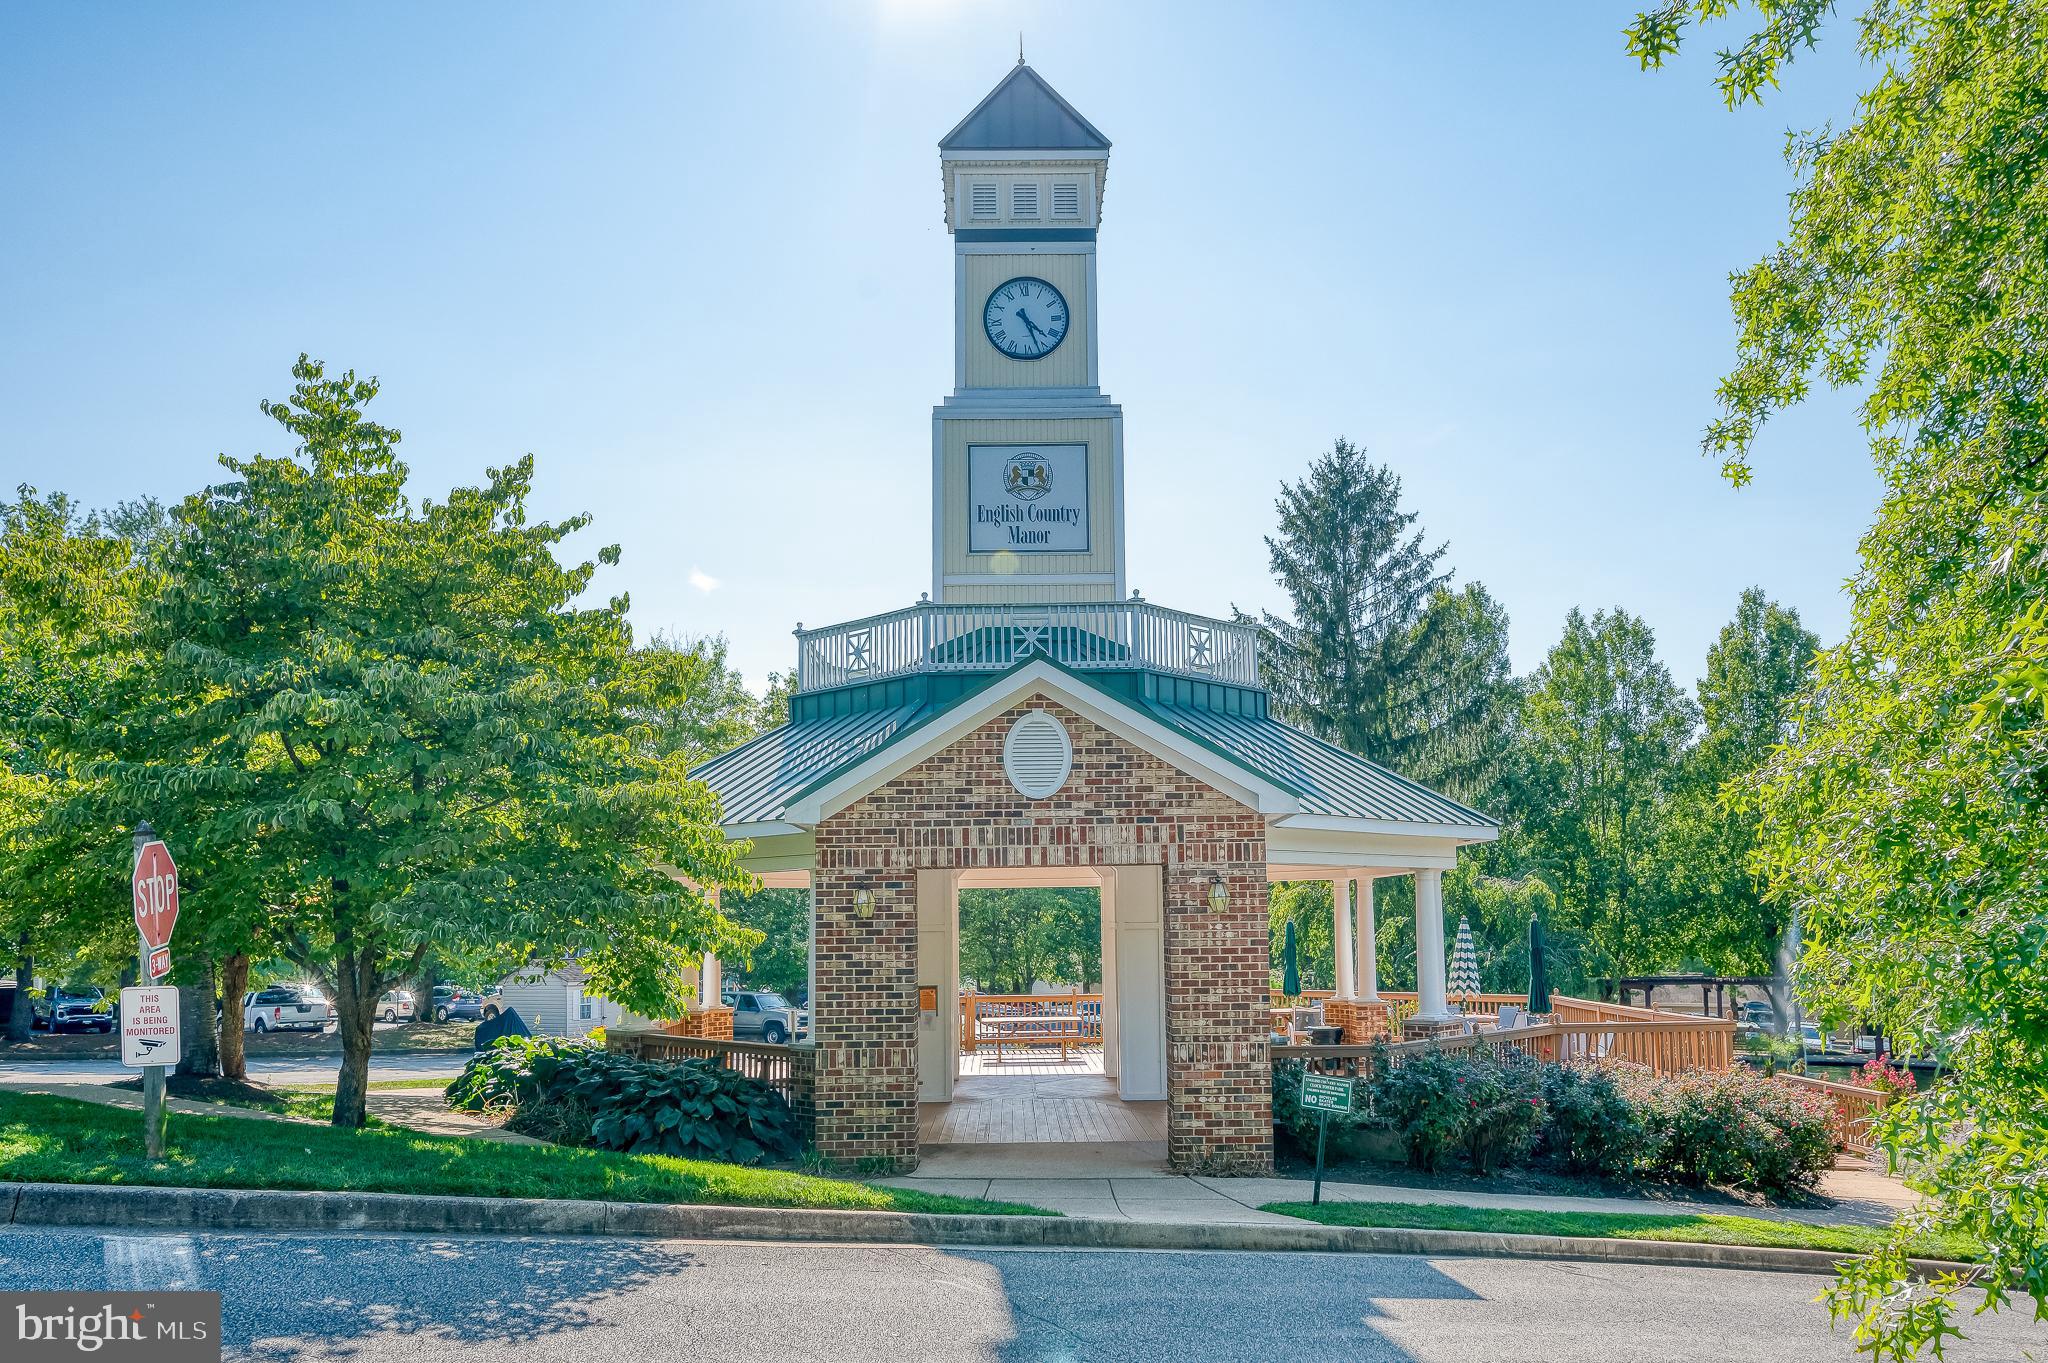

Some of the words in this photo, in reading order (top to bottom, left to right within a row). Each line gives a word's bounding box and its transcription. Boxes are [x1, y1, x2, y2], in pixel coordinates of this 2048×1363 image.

[977, 504, 1024, 528] English
[1027, 503, 1080, 527] Country
[1008, 525, 1051, 544] Manor
[137, 873, 175, 918] STOP
[151, 953, 169, 974] 3-WAY
[140, 994, 159, 1003] THIS
[139, 1005, 161, 1014] AREA
[132, 1016, 141, 1025] IS
[143, 1015, 168, 1025] BEING
[126, 1026, 175, 1037] MONITORED
[1305, 1094, 1317, 1104] NO
